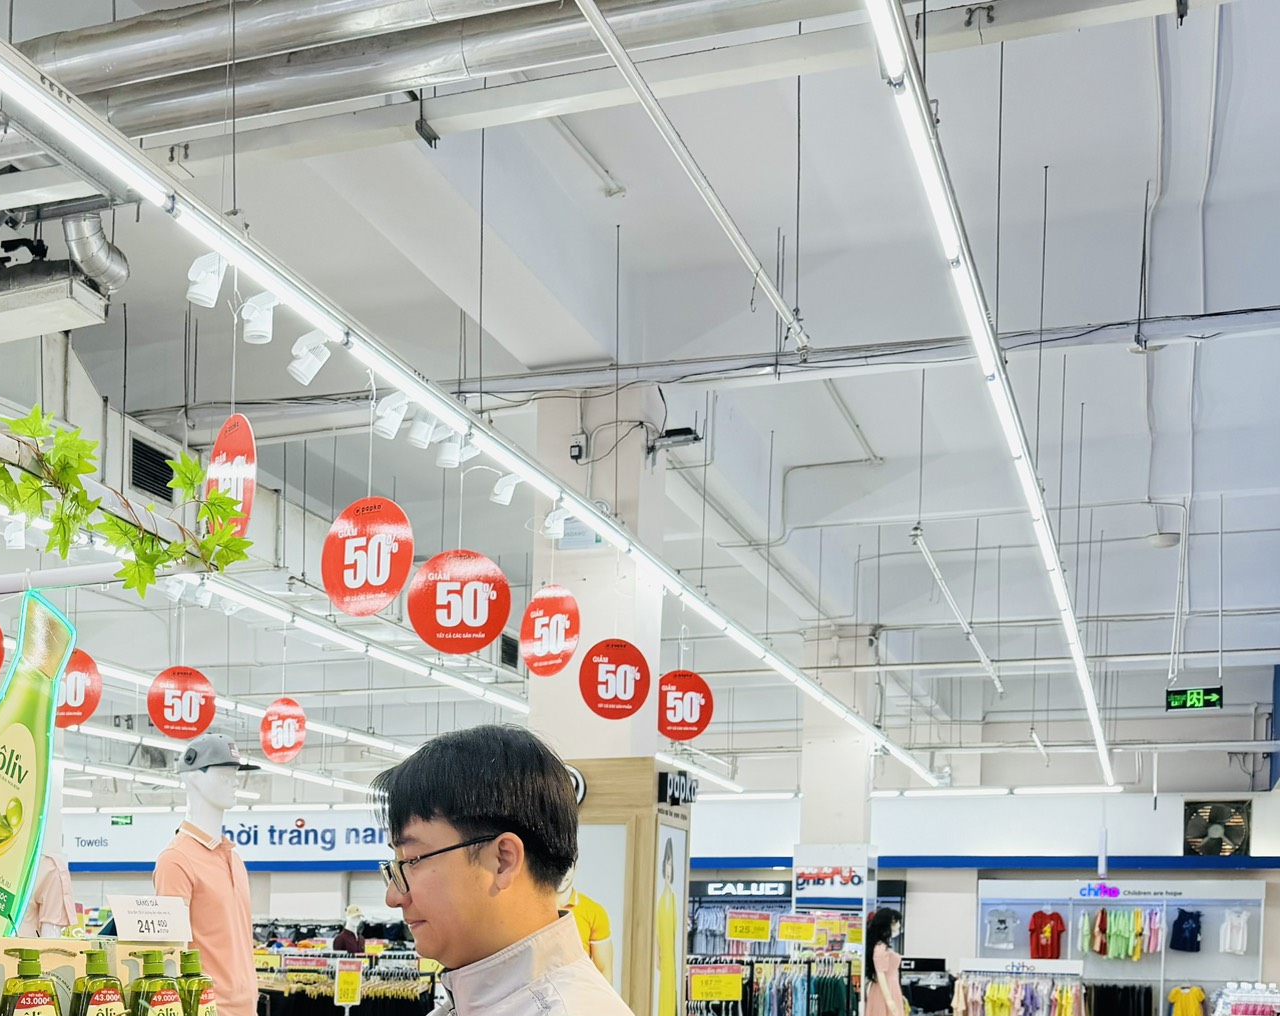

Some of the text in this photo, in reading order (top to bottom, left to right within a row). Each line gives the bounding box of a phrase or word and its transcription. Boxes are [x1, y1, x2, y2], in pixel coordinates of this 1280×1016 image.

[343, 533, 398, 589] 50%
[428, 571, 451, 582] GIẢM
[436, 580, 497, 628] 50%
[533, 613, 571, 657] 50%
[596, 663, 640, 701] 50%
[163, 690, 207, 723] 50%
[665, 691, 705, 723] 50%
[270, 718, 301, 750] 50%
[75, 836, 109, 848] Towels
[1166, 890, 1183, 898] hope
